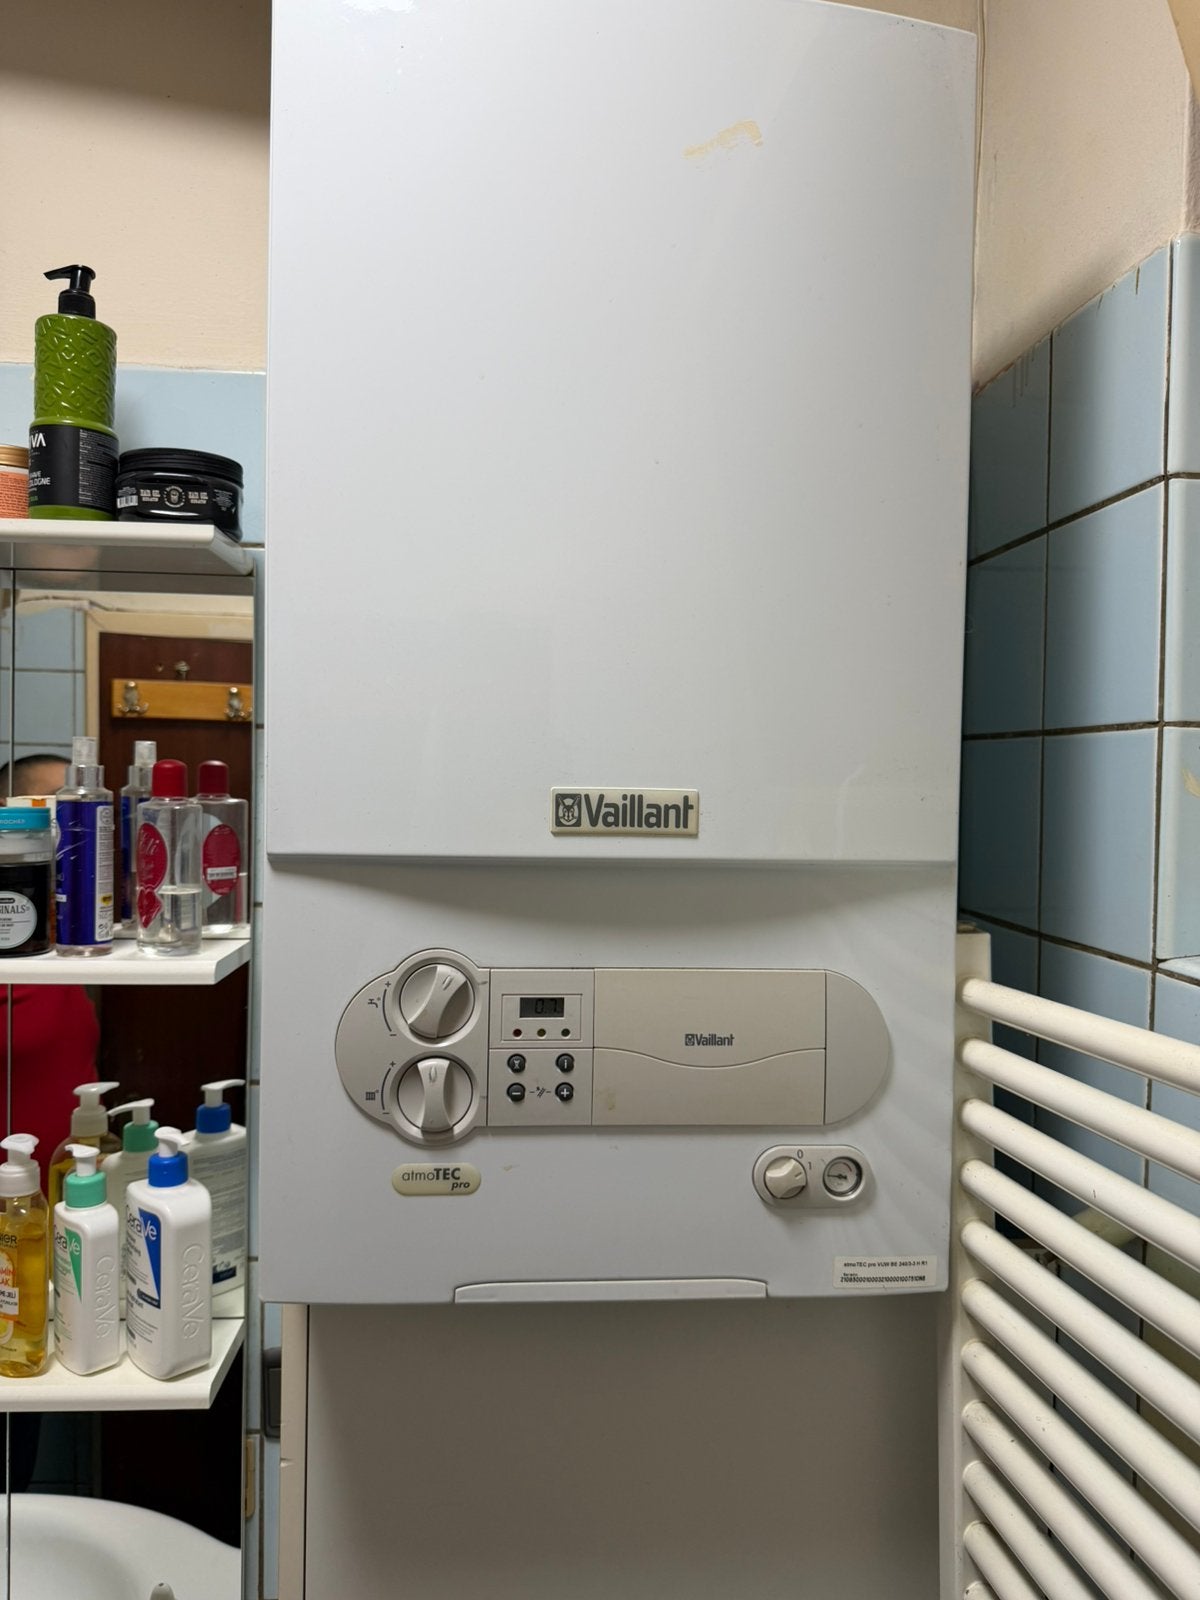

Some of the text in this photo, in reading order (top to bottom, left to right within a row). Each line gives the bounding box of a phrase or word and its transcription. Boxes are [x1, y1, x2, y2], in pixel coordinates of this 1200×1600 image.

[584, 794, 694, 829] Vaillant
[0, 904, 26, 914] INALS
[695, 1033, 735, 1047] Vaillant
[401, 1168, 461, 1182] atmoTEC
[451, 1181, 471, 1191] pro
[95, 1255, 117, 1339] CeraVe
[182, 1243, 206, 1340] CeraVe
